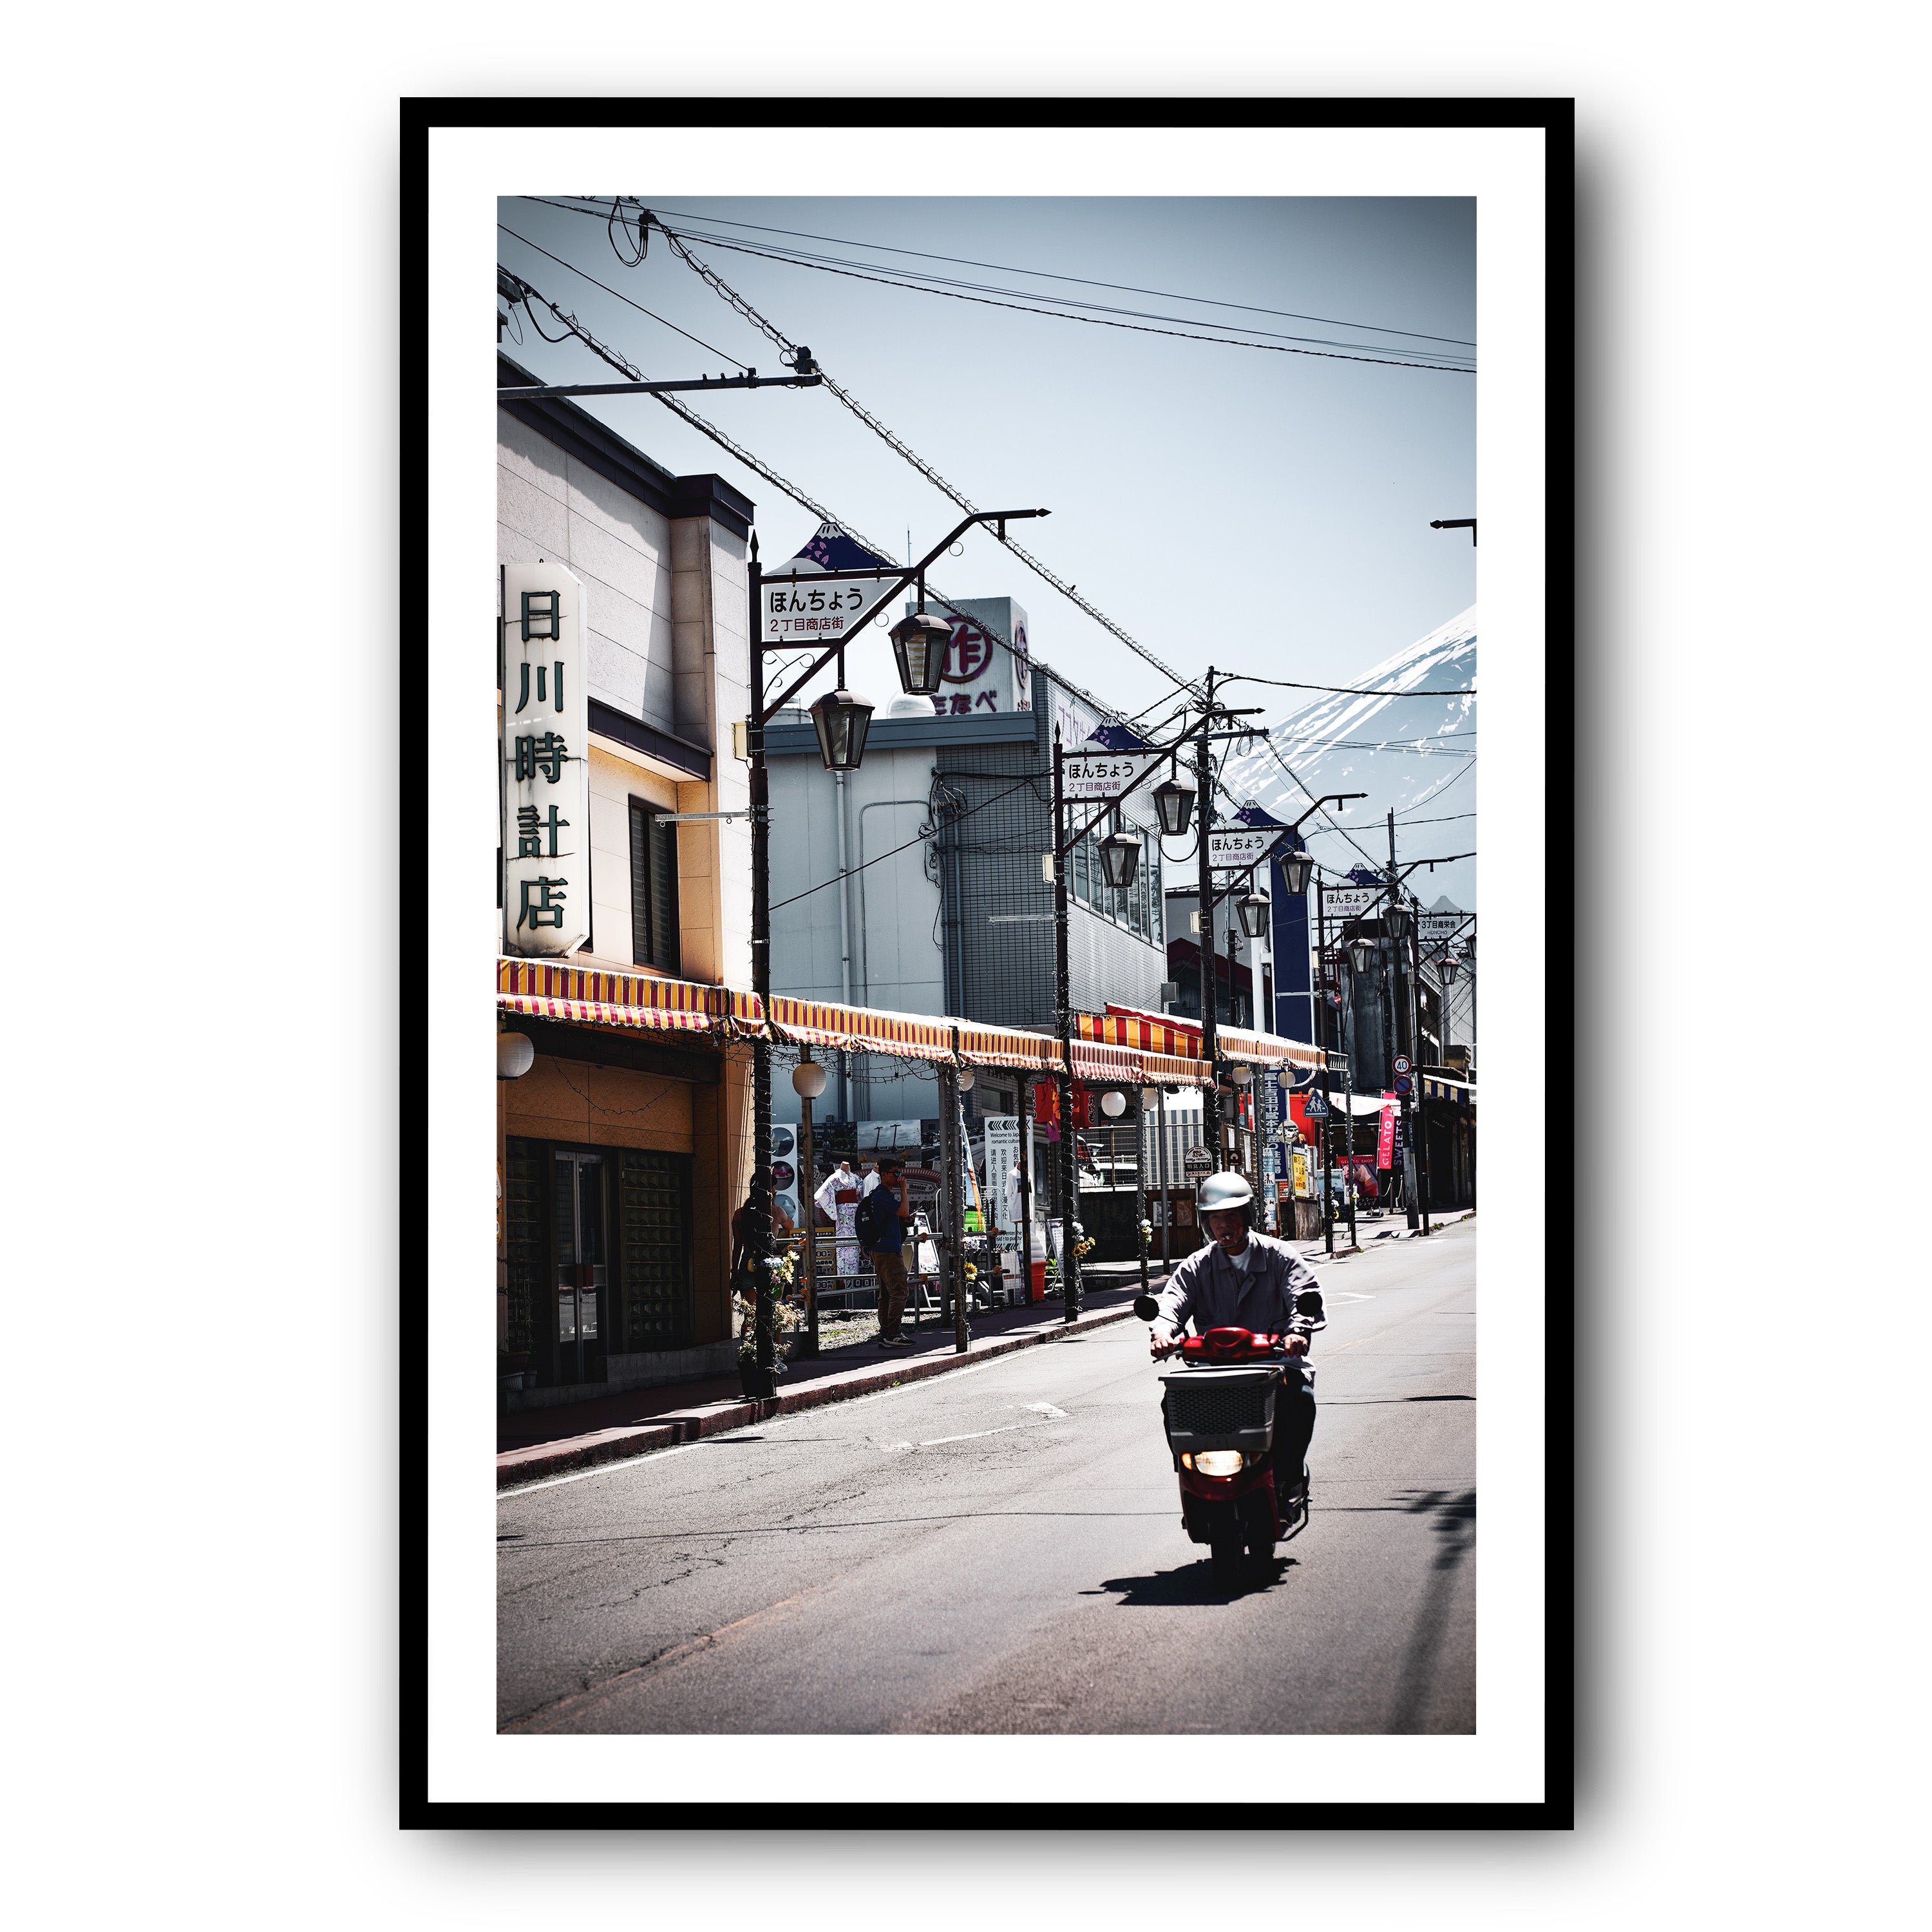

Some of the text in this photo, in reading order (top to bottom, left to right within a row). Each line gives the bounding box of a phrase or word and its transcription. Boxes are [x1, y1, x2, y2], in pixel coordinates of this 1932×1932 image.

[770, 587, 864, 613] ほんちょう
[770, 616, 844, 632] 2丁目商店街
[515, 589, 571, 930] 日川時計店
[1068, 761, 1134, 779] ほんちょう
[1068, 781, 1121, 792] 2丁目商店街
[1211, 836, 1265, 851] ほんちょう
[1212, 852, 1254, 862] 2丁目商店街
[1327, 893, 1370, 904] ほんちょう
[1421, 920, 1456, 929] 3丁目商栄会
[1397, 1060, 1408, 1070] 40
[1382, 1120, 1392, 1166] GELATO
[1394, 1120, 1403, 1166] SWEETS
